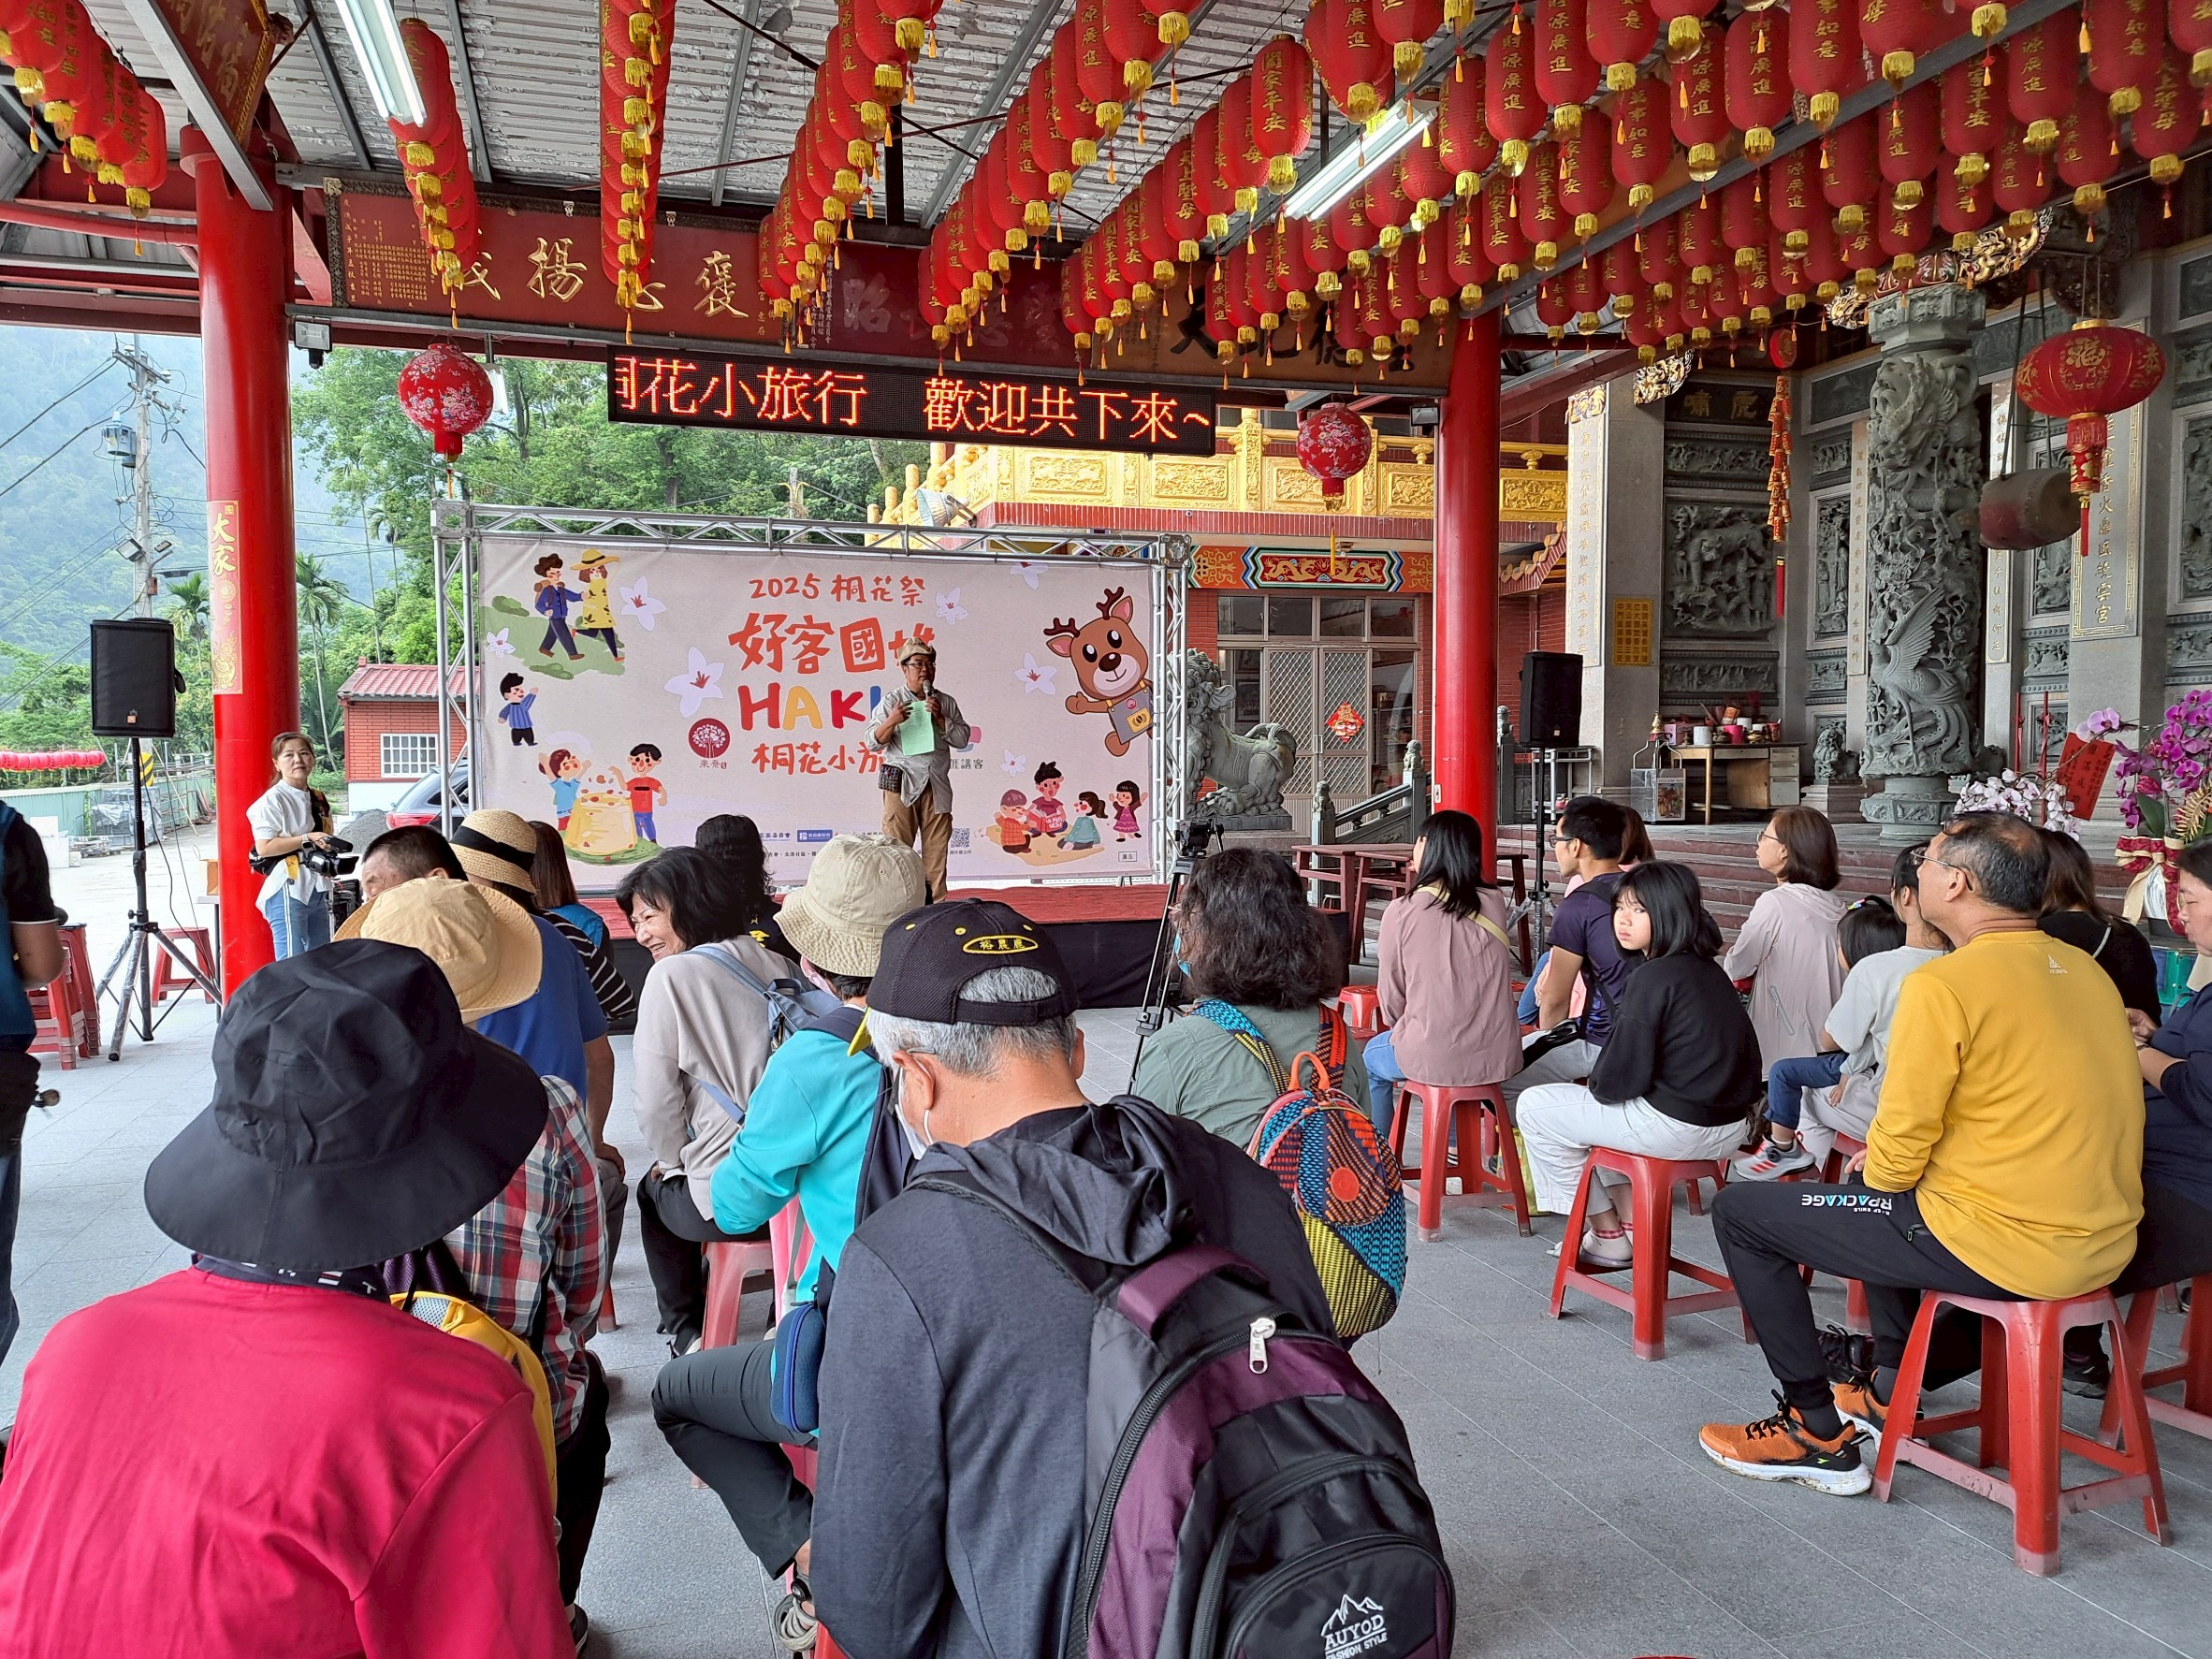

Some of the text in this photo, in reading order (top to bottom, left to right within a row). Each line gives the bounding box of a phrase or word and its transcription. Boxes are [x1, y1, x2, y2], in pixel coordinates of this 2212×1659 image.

[748, 572, 926, 607] 2025 桐花祭
[1324, 1614, 1385, 1651] AUYOD
[1363, 1632, 1389, 1650] STYLE
